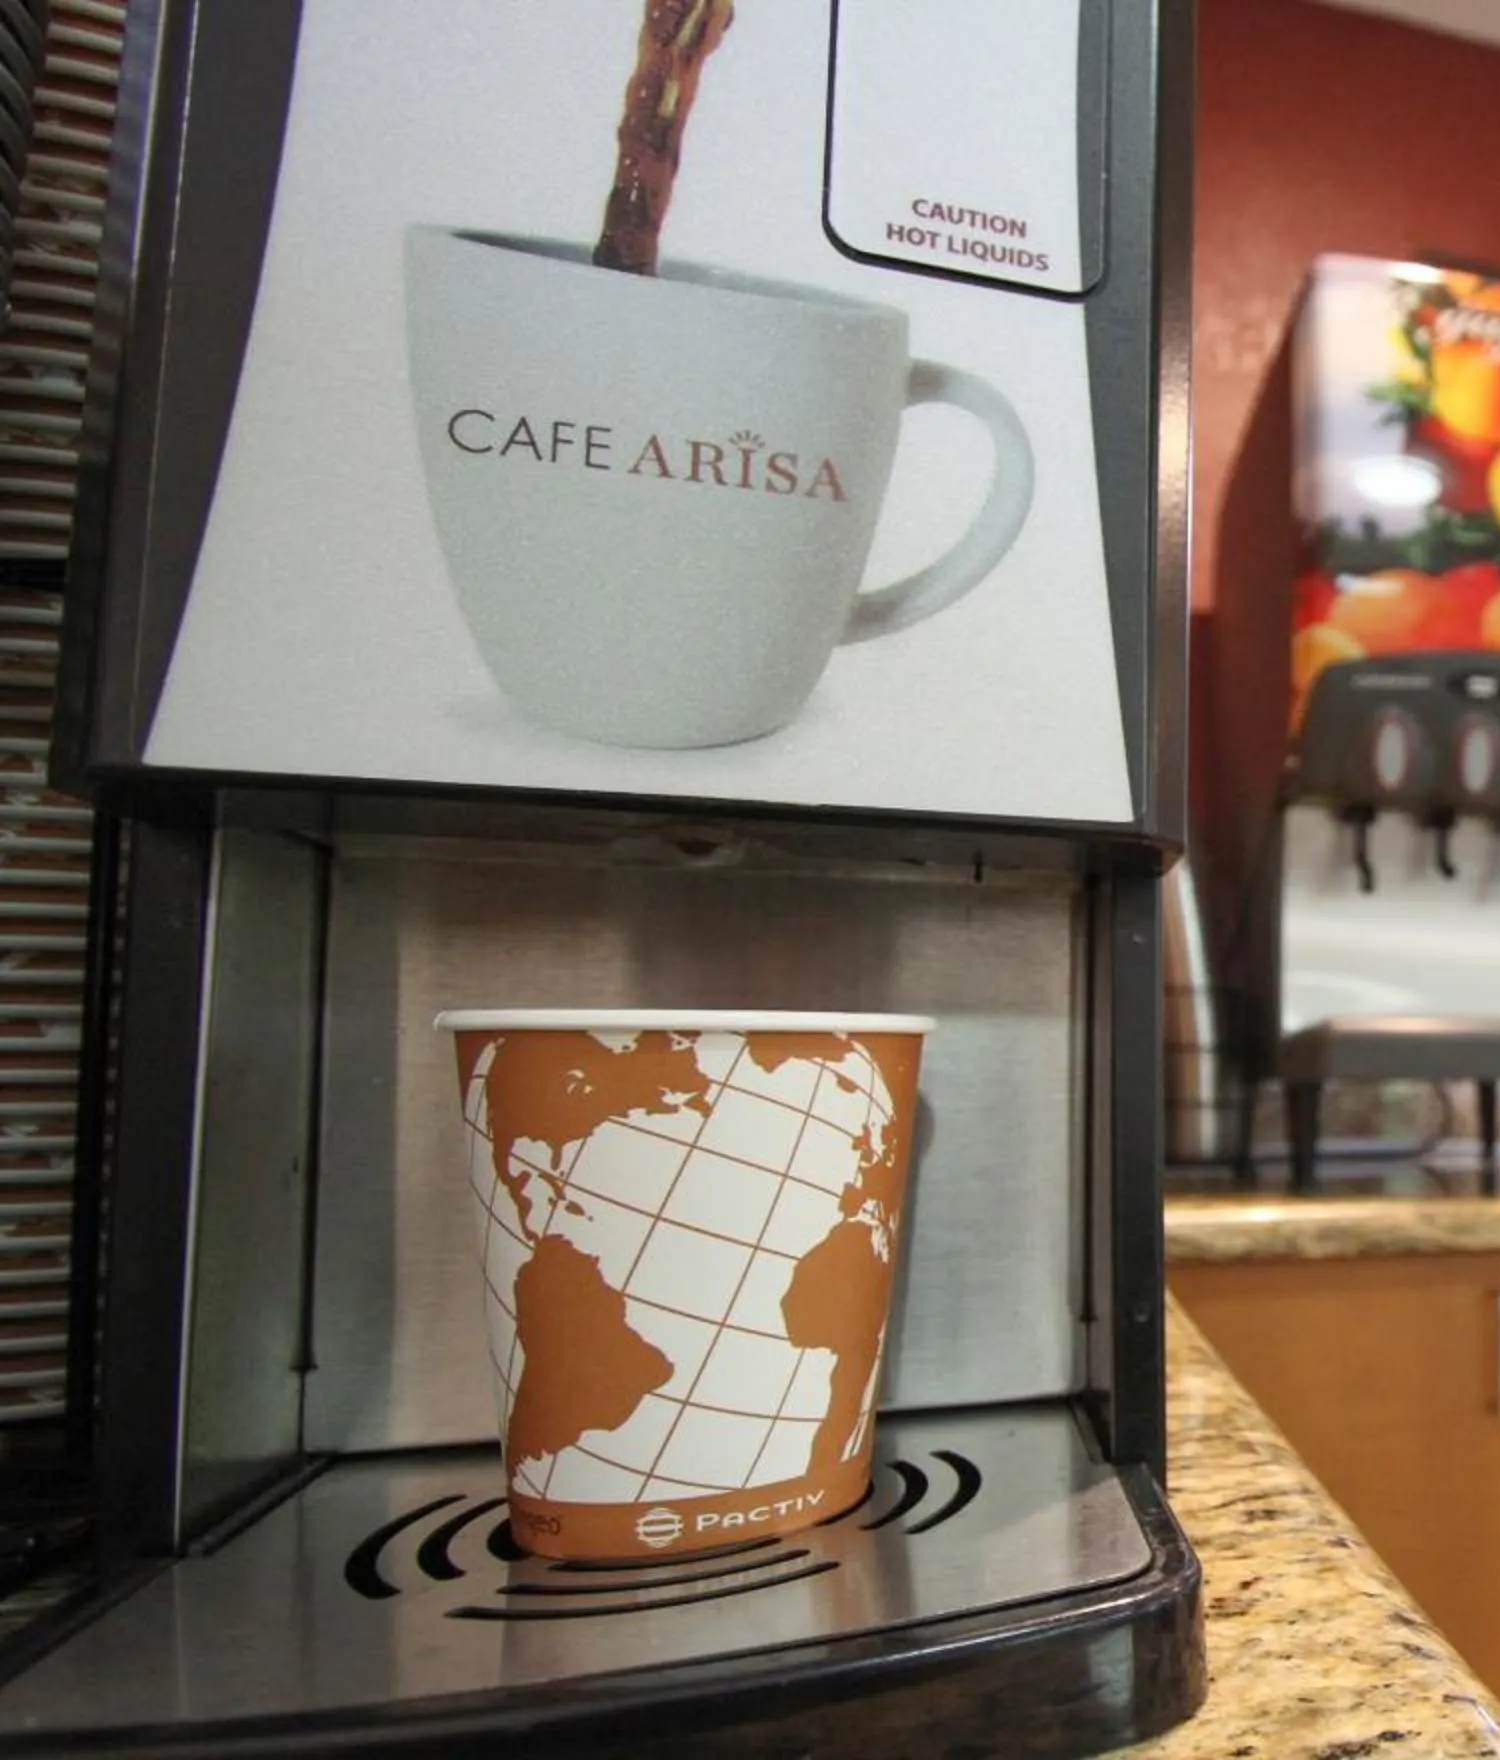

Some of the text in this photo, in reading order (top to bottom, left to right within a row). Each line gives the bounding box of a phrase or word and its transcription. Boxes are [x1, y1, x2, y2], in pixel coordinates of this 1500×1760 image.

[911, 198, 1027, 239] CAUTION
[886, 222, 1050, 272] HOT LIQUIDS
[448, 409, 848, 502] CAFE ARISA
[696, 1489, 824, 1531] PACTIV
